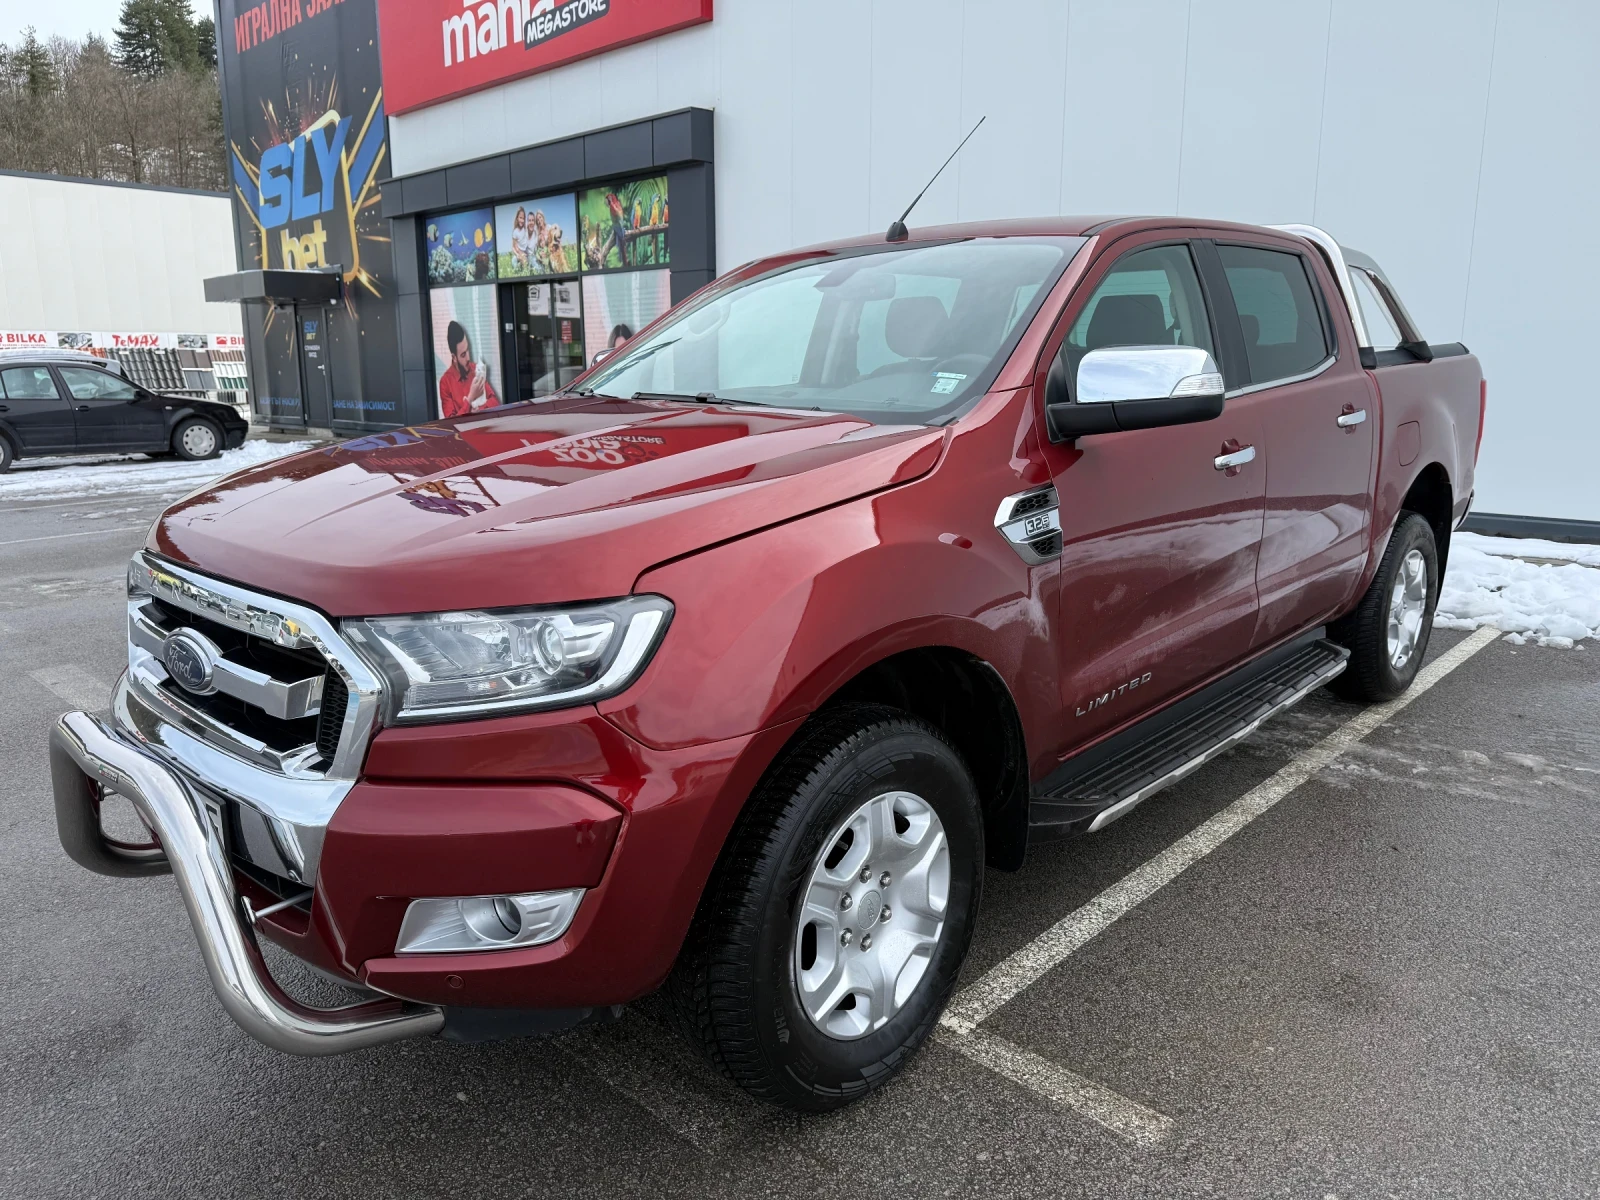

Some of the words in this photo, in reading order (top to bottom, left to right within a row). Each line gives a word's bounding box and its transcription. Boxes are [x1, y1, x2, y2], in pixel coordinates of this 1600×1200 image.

[234, 0, 302, 54] ИГРАЛНА
[526, 0, 607, 44] MEGASTORE
[259, 115, 353, 229] SLY
[280, 219, 328, 270] bet
[6, 333, 47, 343] BILKA
[354, 401, 395, 411] ЗАВИСИМОСТ
[167, 644, 193, 679] Ford
[1075, 672, 1152, 717] LIMITED
